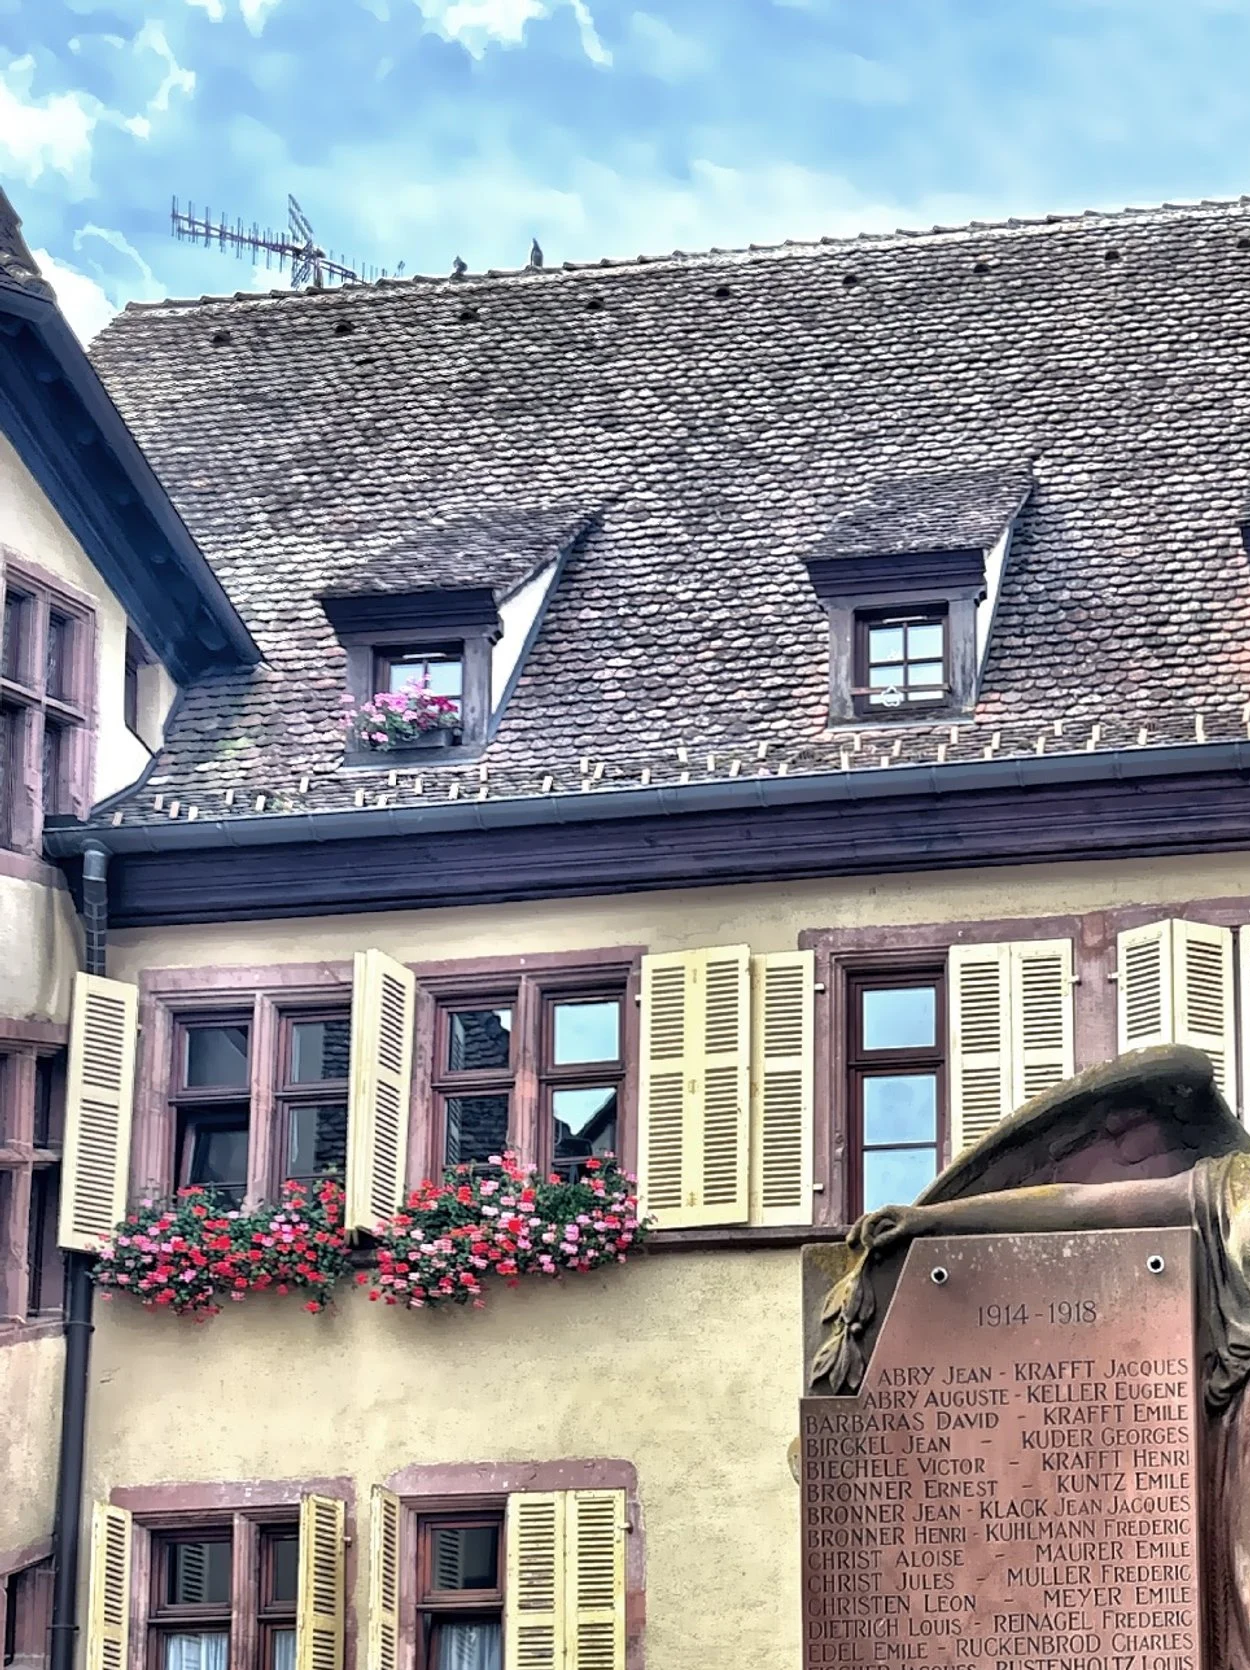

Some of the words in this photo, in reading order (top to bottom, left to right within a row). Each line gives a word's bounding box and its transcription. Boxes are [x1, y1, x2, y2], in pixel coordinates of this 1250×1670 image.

[878, 1366, 934, 1386] ABRY
[942, 1366, 991, 1385] JEAN
[1014, 1360, 1095, 1380] KRAFFT
[1103, 1358, 1187, 1378] JACQUES
[806, 1412, 924, 1435] BARBARAS
[936, 1411, 998, 1430] DAVID
[1044, 1404, 1124, 1425] KRAFFT
[1133, 1403, 1188, 1422] EMILE
[807, 1480, 912, 1502] BRONNER
[924, 1479, 997, 1498] ERNEST
[1057, 1472, 1125, 1492] KUNTZ
[1135, 1471, 1189, 1490] EMILE
[808, 1549, 882, 1569] CHRIST
[895, 1549, 963, 1567] ALOISE
[1036, 1540, 1123, 1562] MAURER
[1135, 1539, 1190, 1559] EMILE
[809, 1617, 897, 1639] DIETRICH
[908, 1617, 961, 1636] LOUIS
[993, 1611, 1092, 1633] REINAGEL
[1102, 1609, 1192, 1629] FREDERIC
